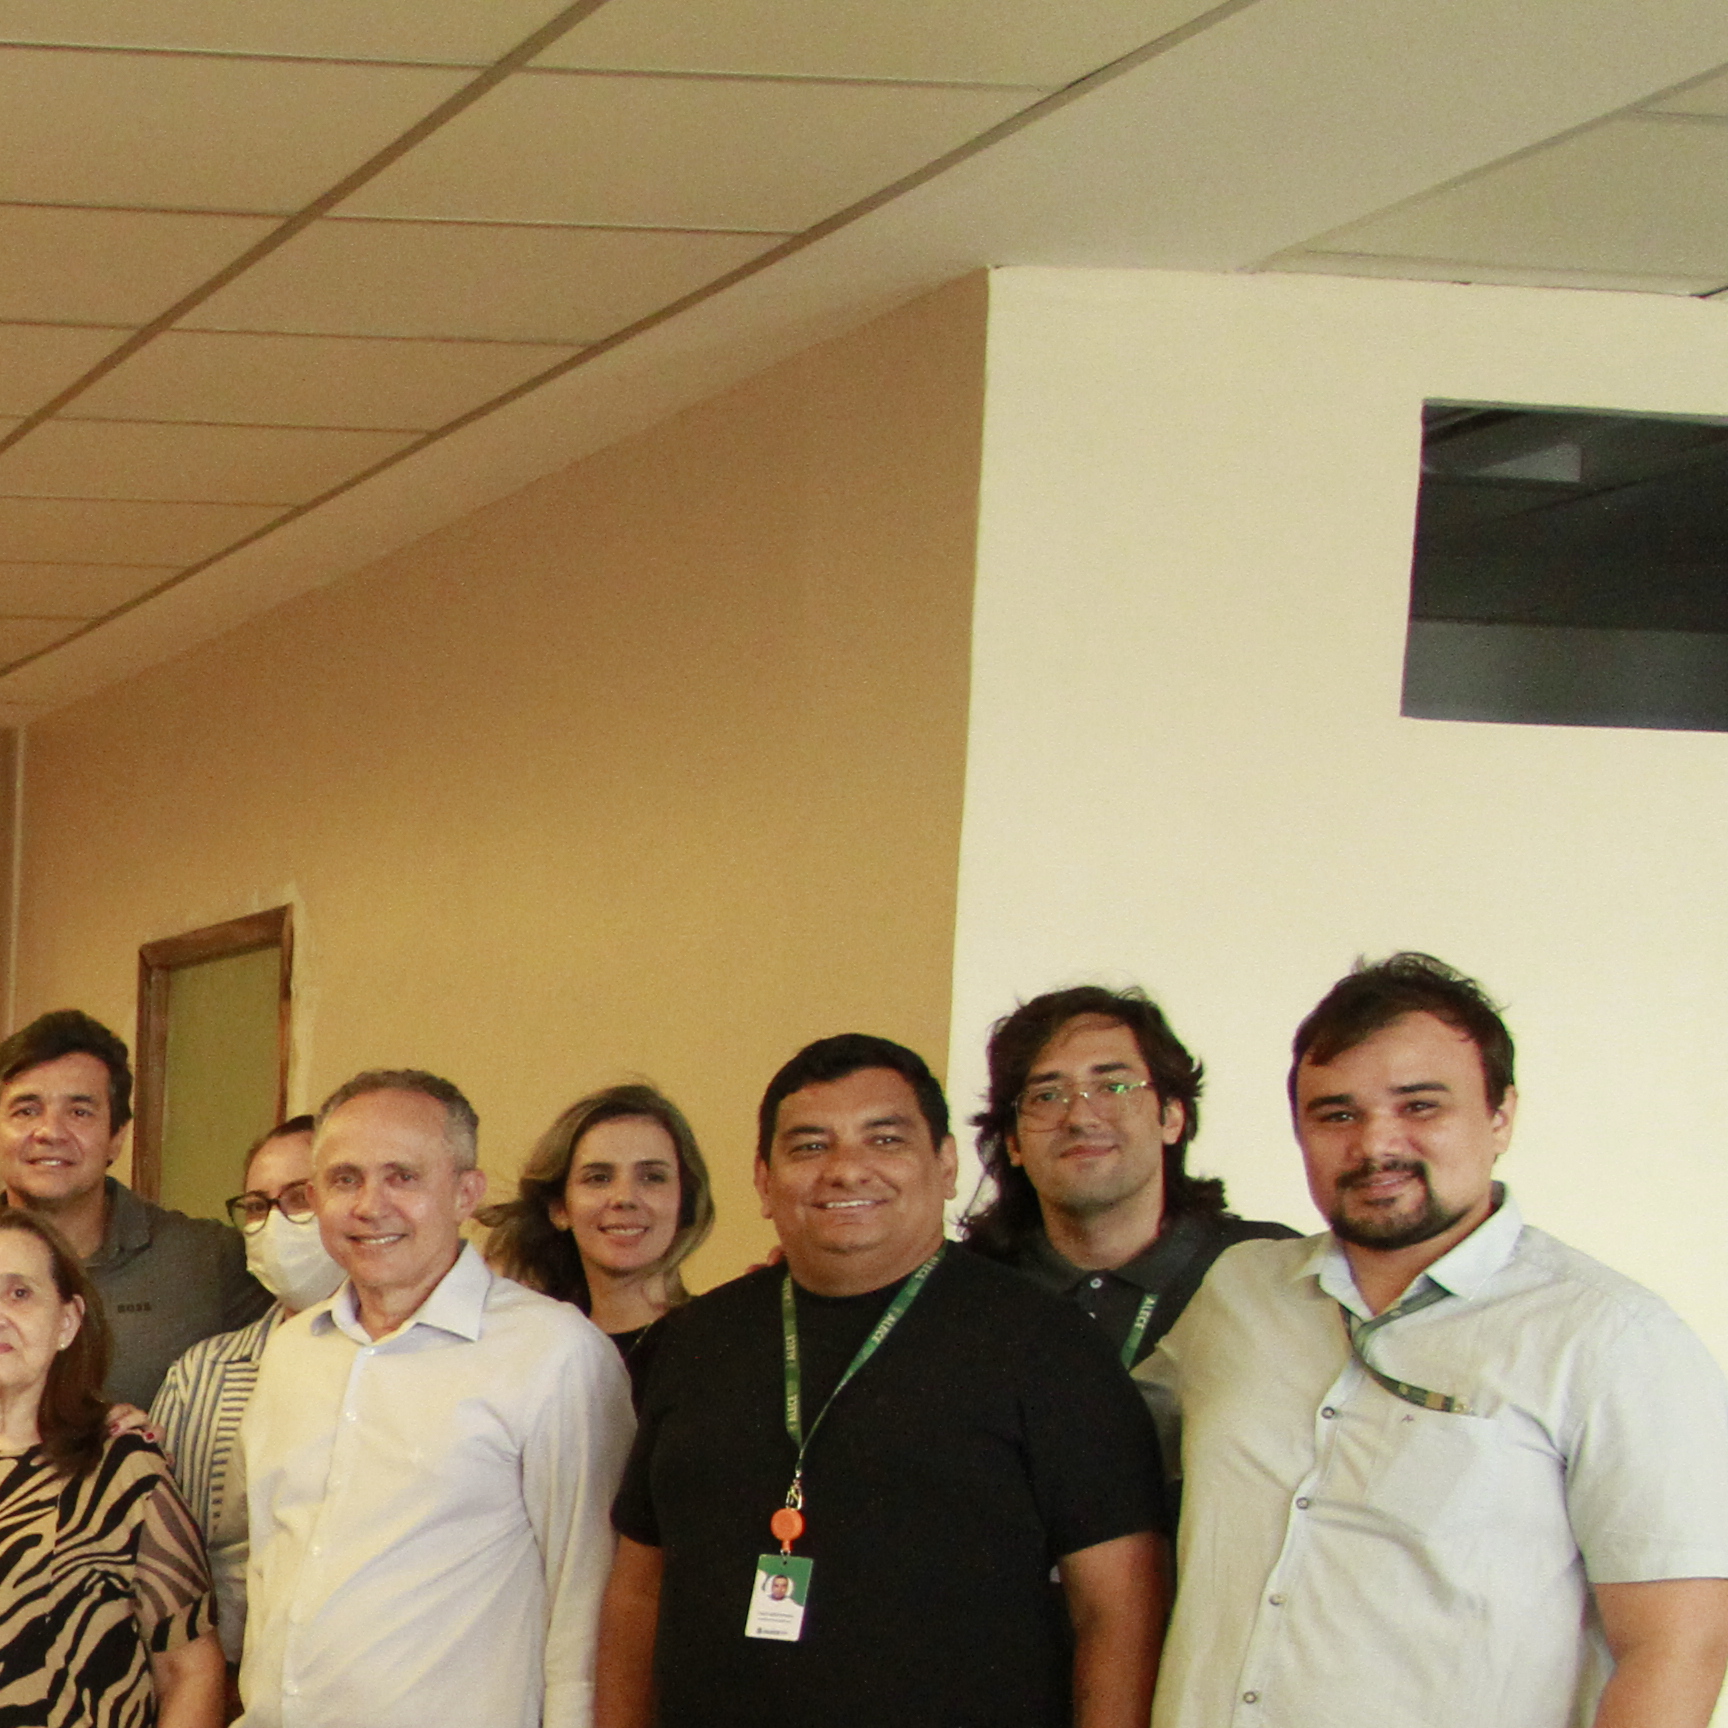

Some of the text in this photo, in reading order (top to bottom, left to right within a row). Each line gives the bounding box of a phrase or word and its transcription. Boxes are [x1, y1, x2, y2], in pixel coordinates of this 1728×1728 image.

[872, 1312, 897, 1342] ALECE
[1134, 1296, 1156, 1329] ALECE
[785, 1334, 798, 1361] ALECE
[786, 1394, 800, 1422] ALECE
